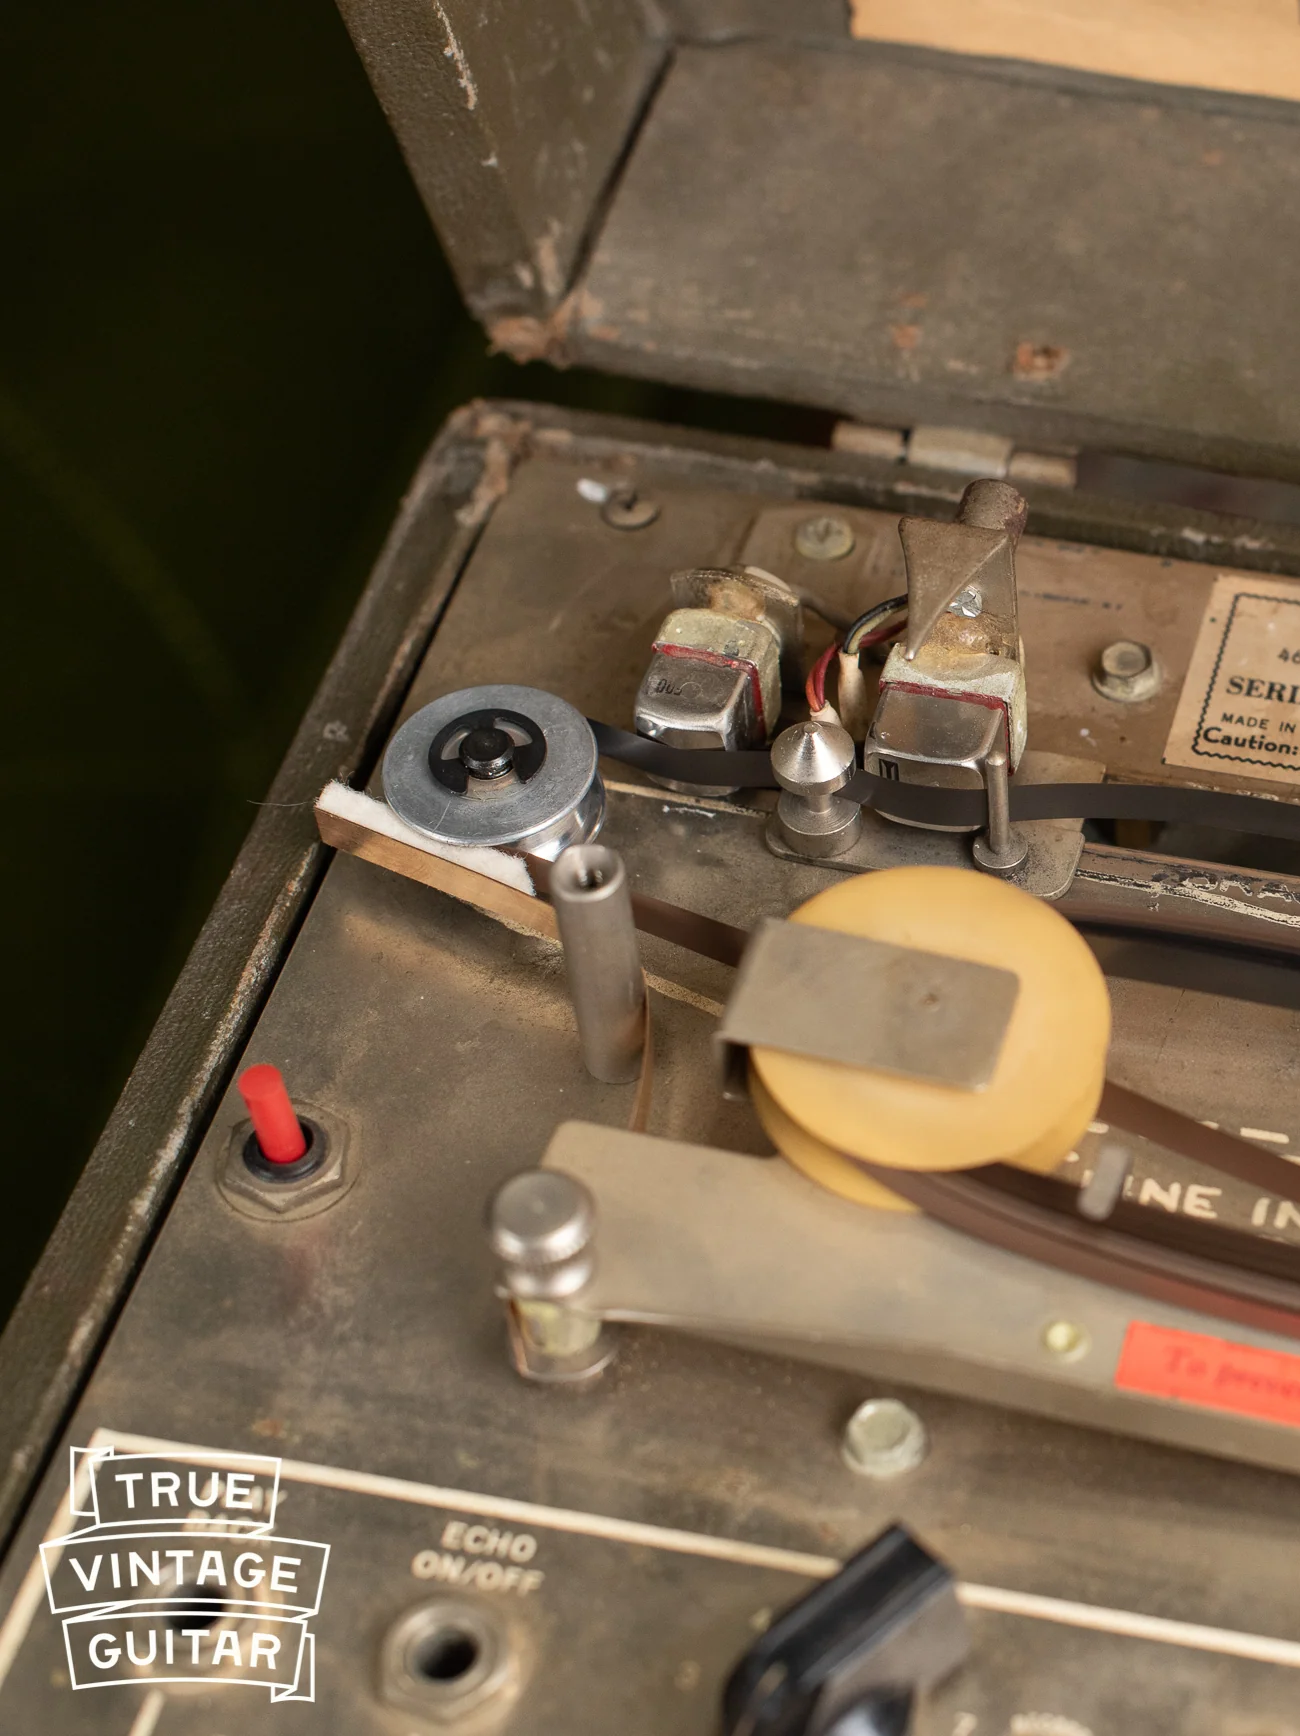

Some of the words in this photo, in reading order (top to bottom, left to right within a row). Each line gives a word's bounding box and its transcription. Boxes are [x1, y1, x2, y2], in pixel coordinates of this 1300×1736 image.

[1221, 712, 1269, 730] MADE
[1279, 721, 1297, 734] IN
[1203, 726, 1299, 756] Caution:
[441, 1520, 538, 1561] ECHO
[412, 1549, 545, 1597] ON/OFF
